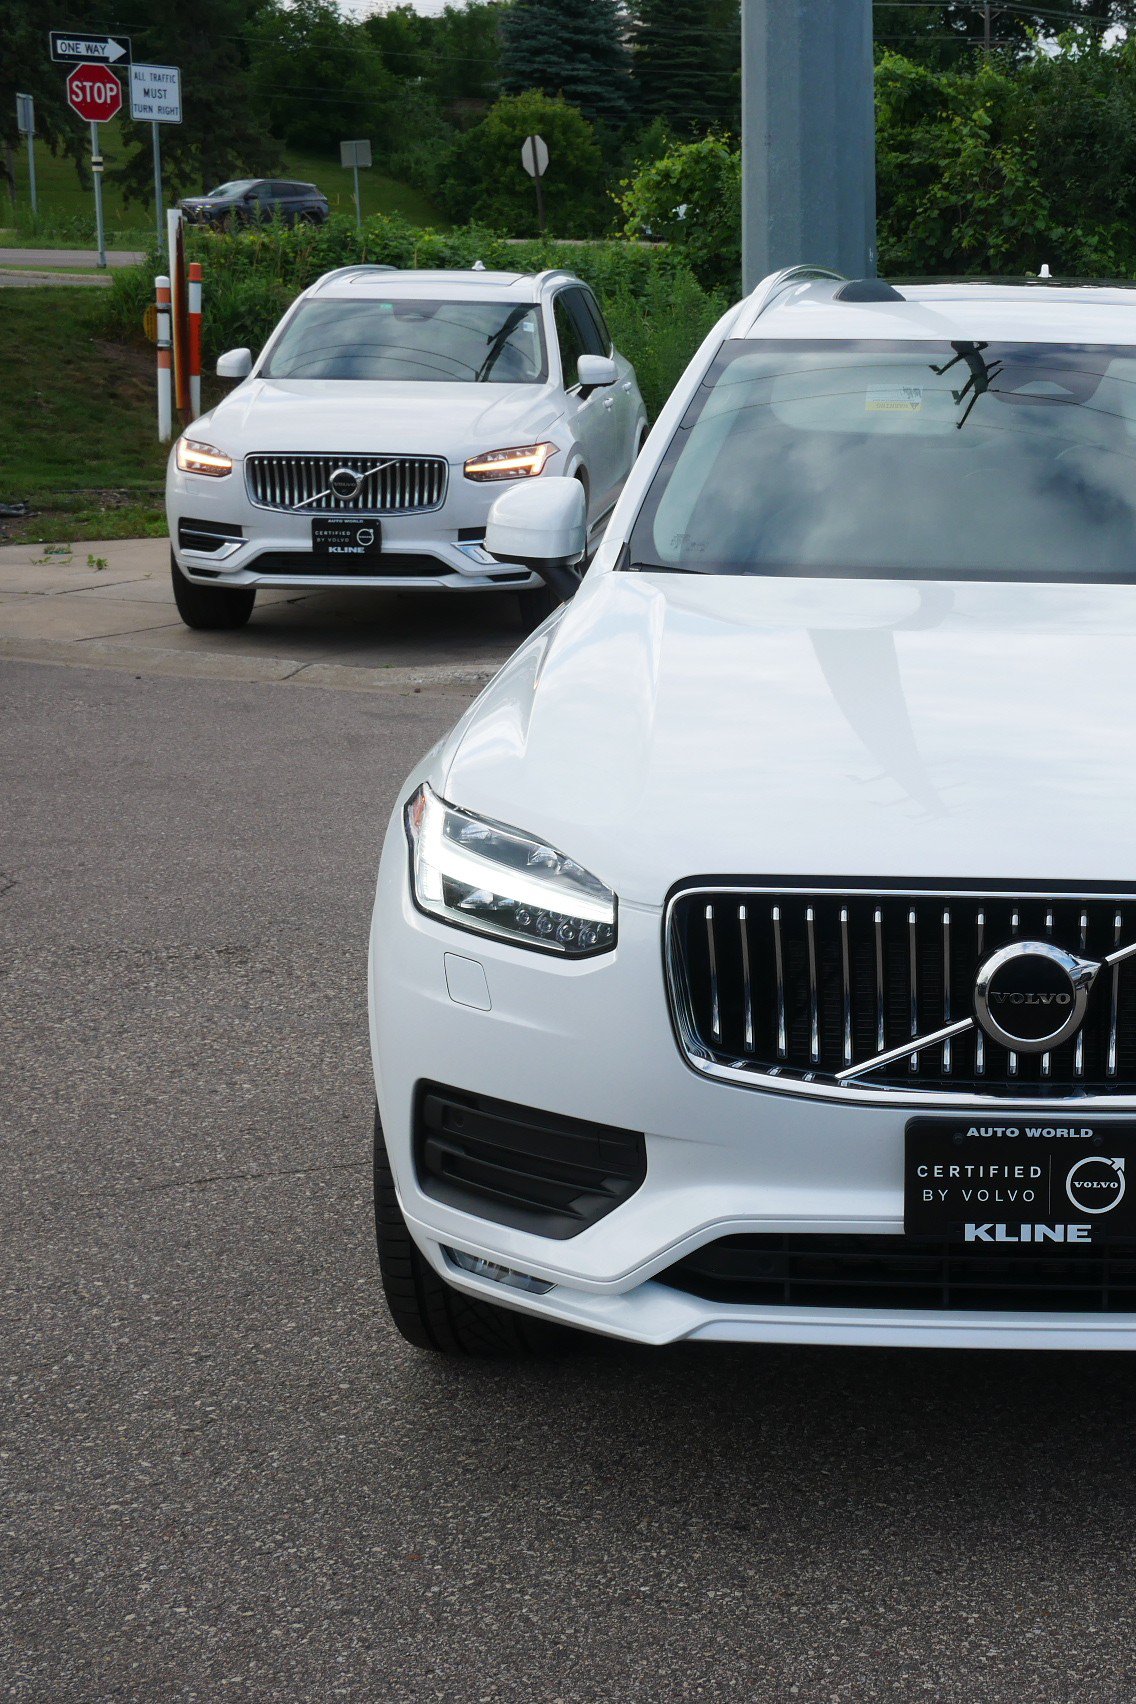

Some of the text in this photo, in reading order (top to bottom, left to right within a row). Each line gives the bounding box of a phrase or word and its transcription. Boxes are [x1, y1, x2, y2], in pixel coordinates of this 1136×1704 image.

[60, 42, 107, 55] ONE WAY
[134, 72, 176, 84] ALL TRAFFIC
[72, 81, 117, 103] STOP
[143, 88, 167, 99] MUST
[134, 104, 179, 116] TURN RIGHT
[990, 991, 1071, 1005] VOLVO
[966, 1127, 1094, 1138] AUTO WORLD
[917, 1165, 1042, 1178] CERTIFIED
[1073, 1181, 1119, 1189] VOLVO
[922, 1189, 1035, 1202] BY VOLVO
[964, 1223, 1092, 1243] KLINE
